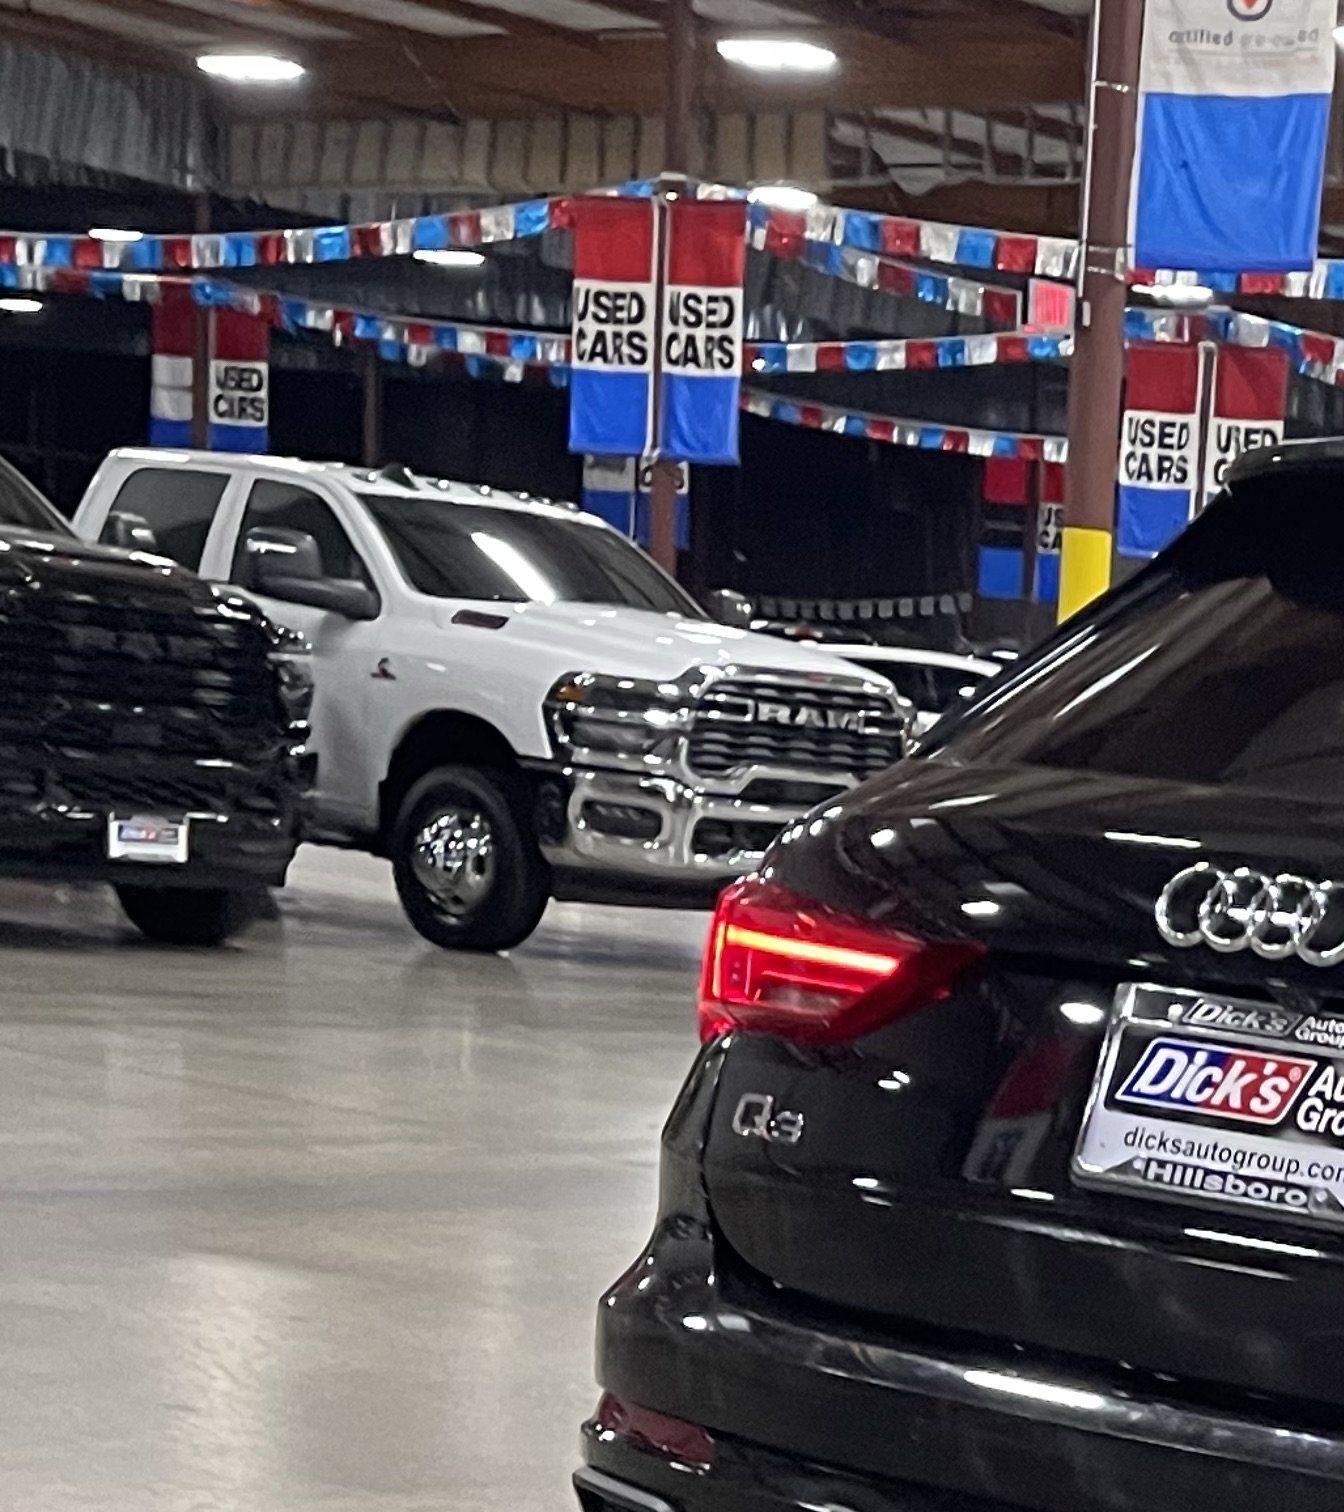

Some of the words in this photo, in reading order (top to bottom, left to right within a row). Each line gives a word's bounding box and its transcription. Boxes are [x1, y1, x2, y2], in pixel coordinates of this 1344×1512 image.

[575, 326, 648, 365] CARS
[665, 332, 734, 369] CARS
[1127, 417, 1191, 450] USED
[1124, 451, 1189, 484] CARS
[1146, 1157, 1308, 1207] Hillsboro
